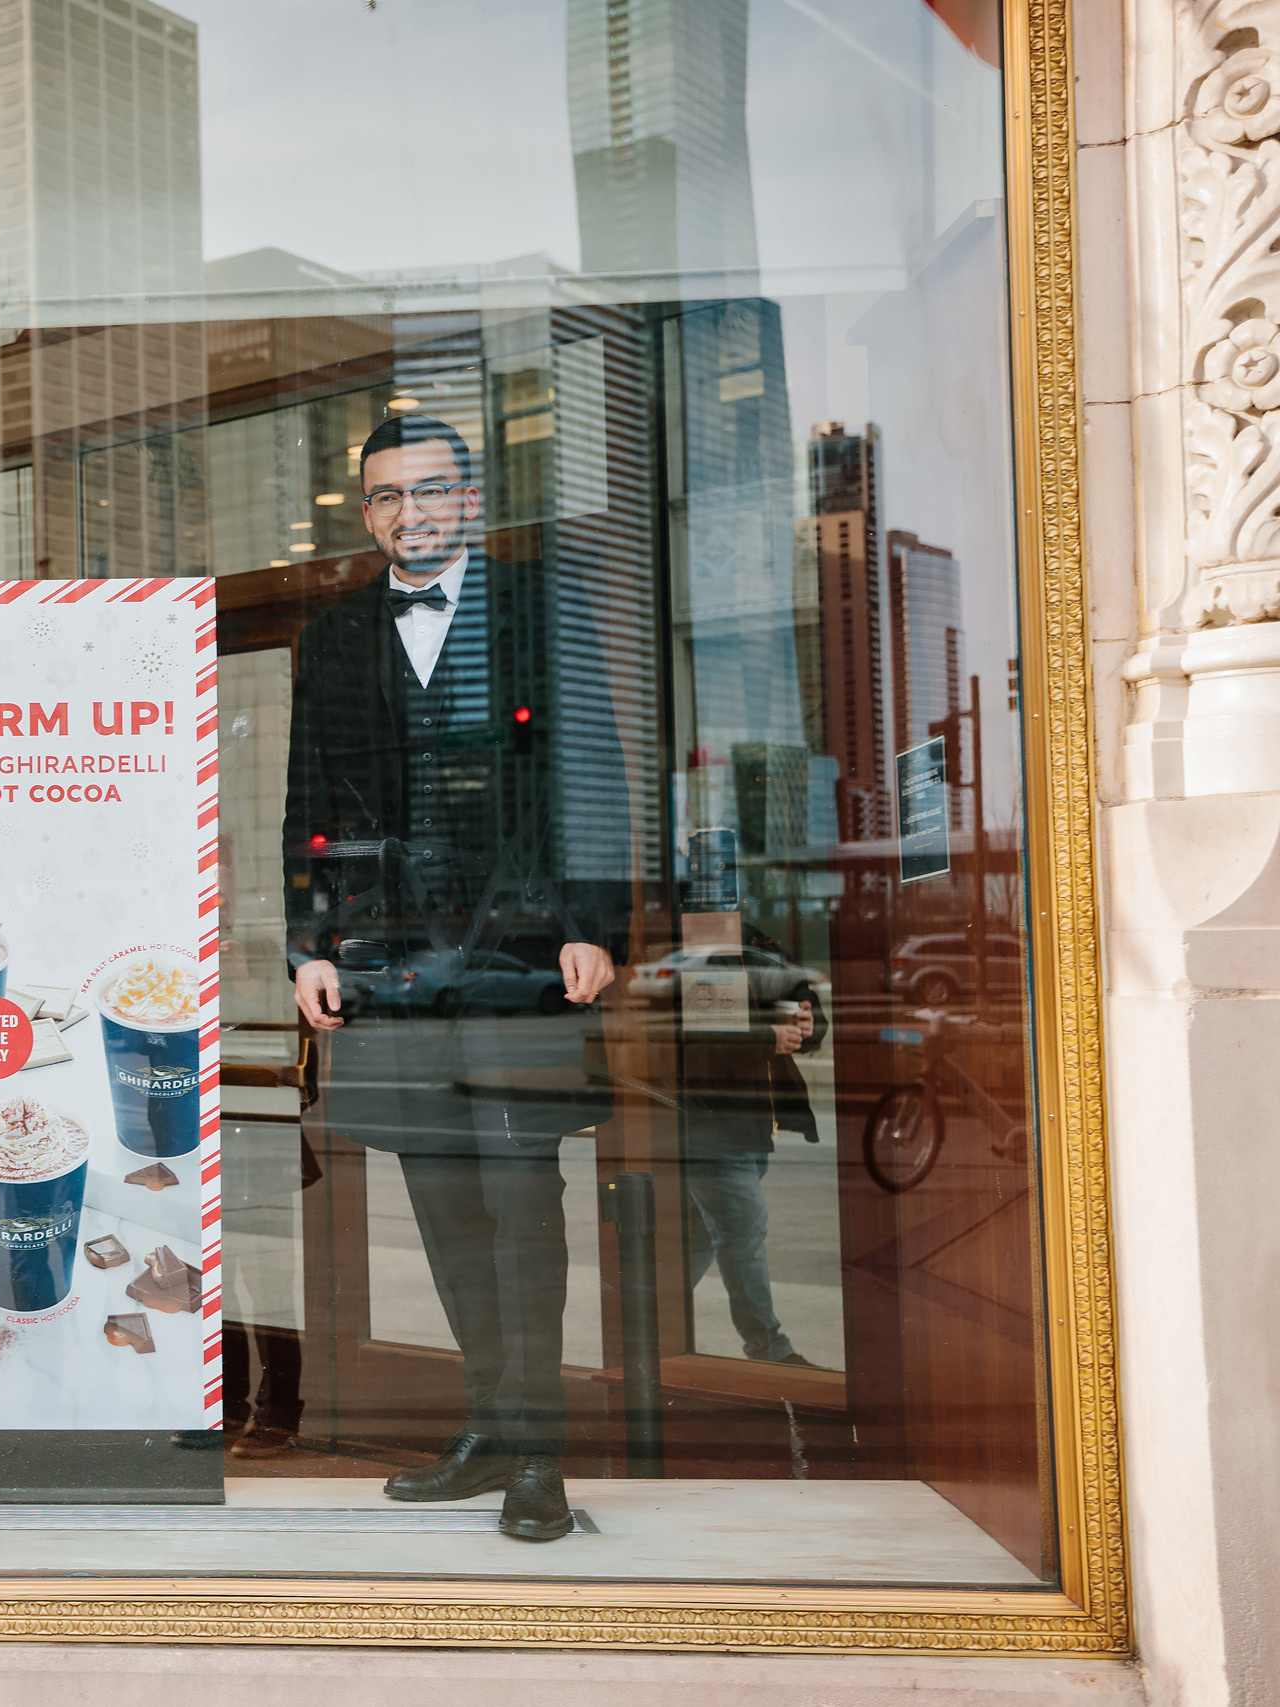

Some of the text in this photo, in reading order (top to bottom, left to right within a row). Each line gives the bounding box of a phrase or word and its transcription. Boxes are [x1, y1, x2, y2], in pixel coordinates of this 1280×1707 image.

[93, 701, 174, 735] UP!
[29, 784, 122, 803] COCOA
[80, 943, 198, 994] SEA SALT CARAMEL HOT COCOA
[118, 1071, 200, 1090] GHIRARDEL
[6, 1295, 82, 1325] CLASSIC HOT COCOA
